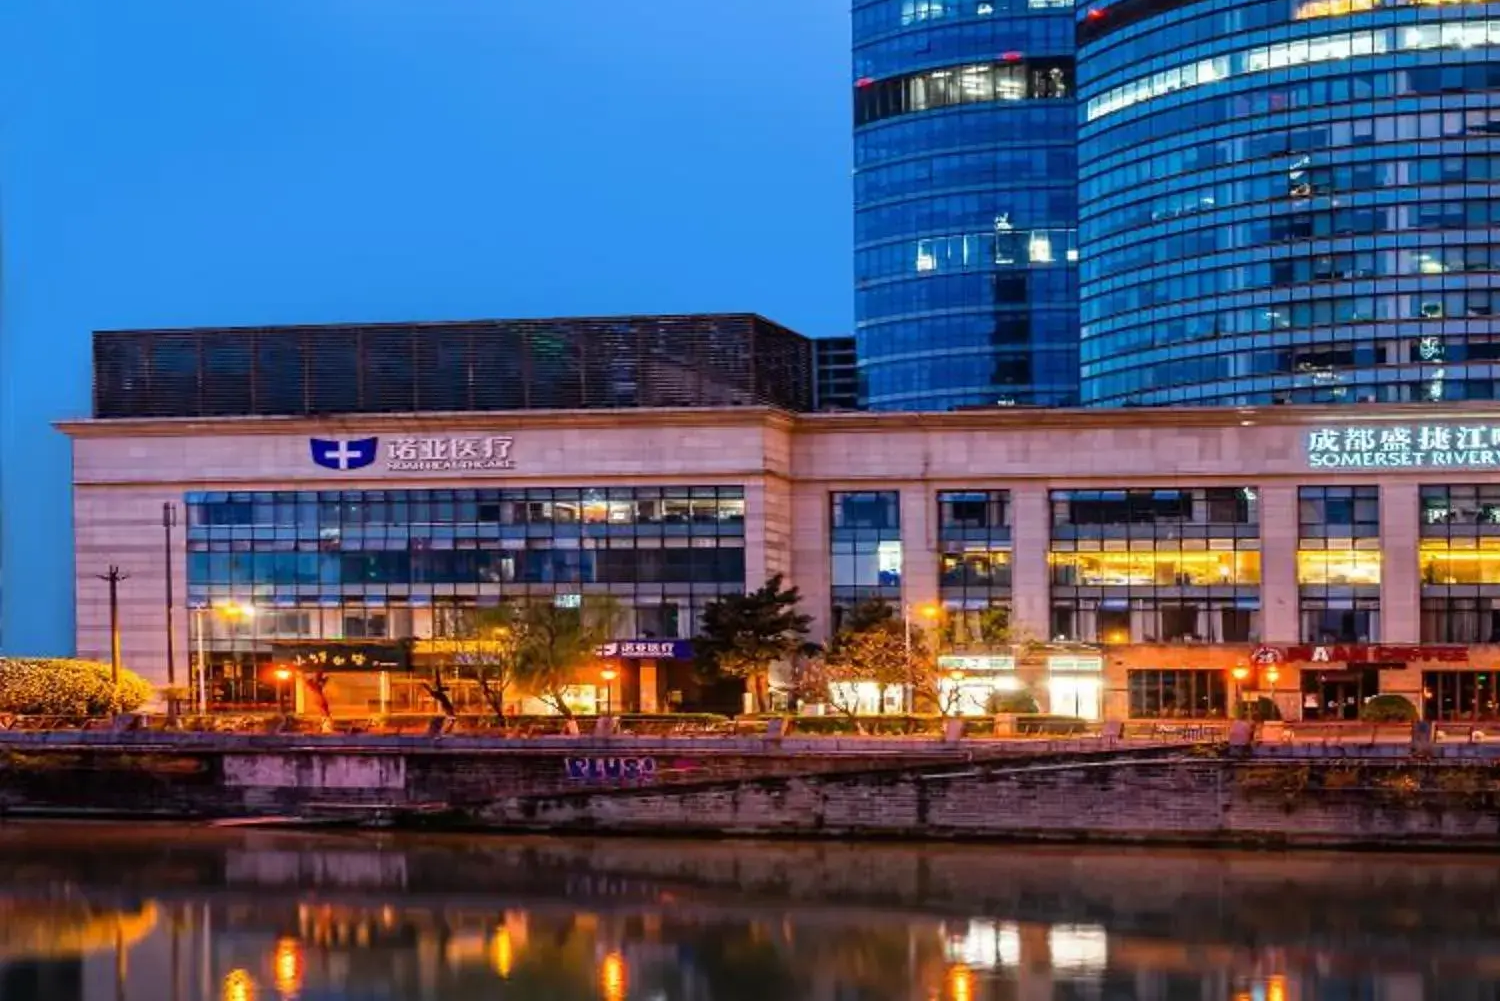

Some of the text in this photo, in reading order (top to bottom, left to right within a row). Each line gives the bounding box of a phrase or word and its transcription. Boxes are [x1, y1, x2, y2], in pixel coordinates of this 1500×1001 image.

[387, 436, 513, 459] 诺亚医疗
[1309, 451, 1426, 467] SOMERSET
